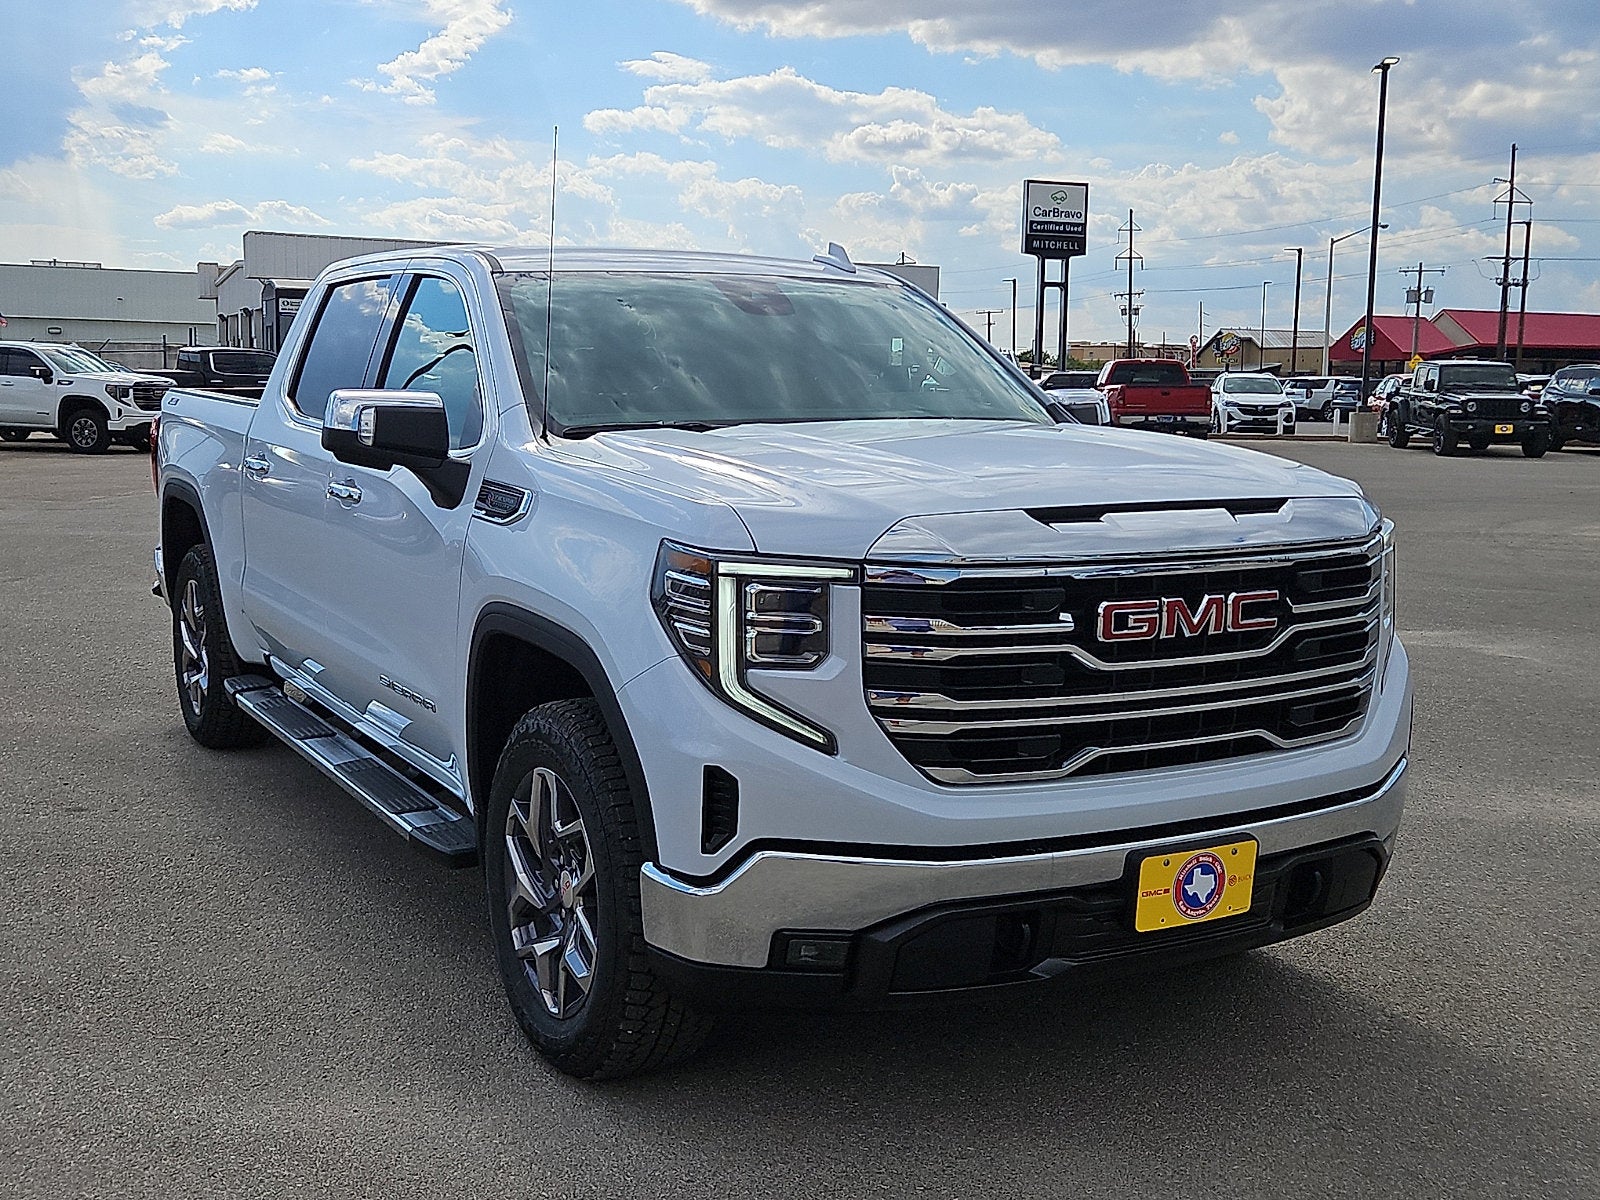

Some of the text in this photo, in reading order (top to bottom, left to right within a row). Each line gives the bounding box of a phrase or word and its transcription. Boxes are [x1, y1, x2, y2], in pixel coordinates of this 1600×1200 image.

[1032, 206, 1083, 219] CarBravo
[1032, 223, 1082, 232] Certified Used
[1032, 240, 1080, 250] MITCHELL
[1097, 590, 1280, 642] GMC
[379, 673, 437, 714] SIERRA
[1141, 889, 1163, 898] GMC
